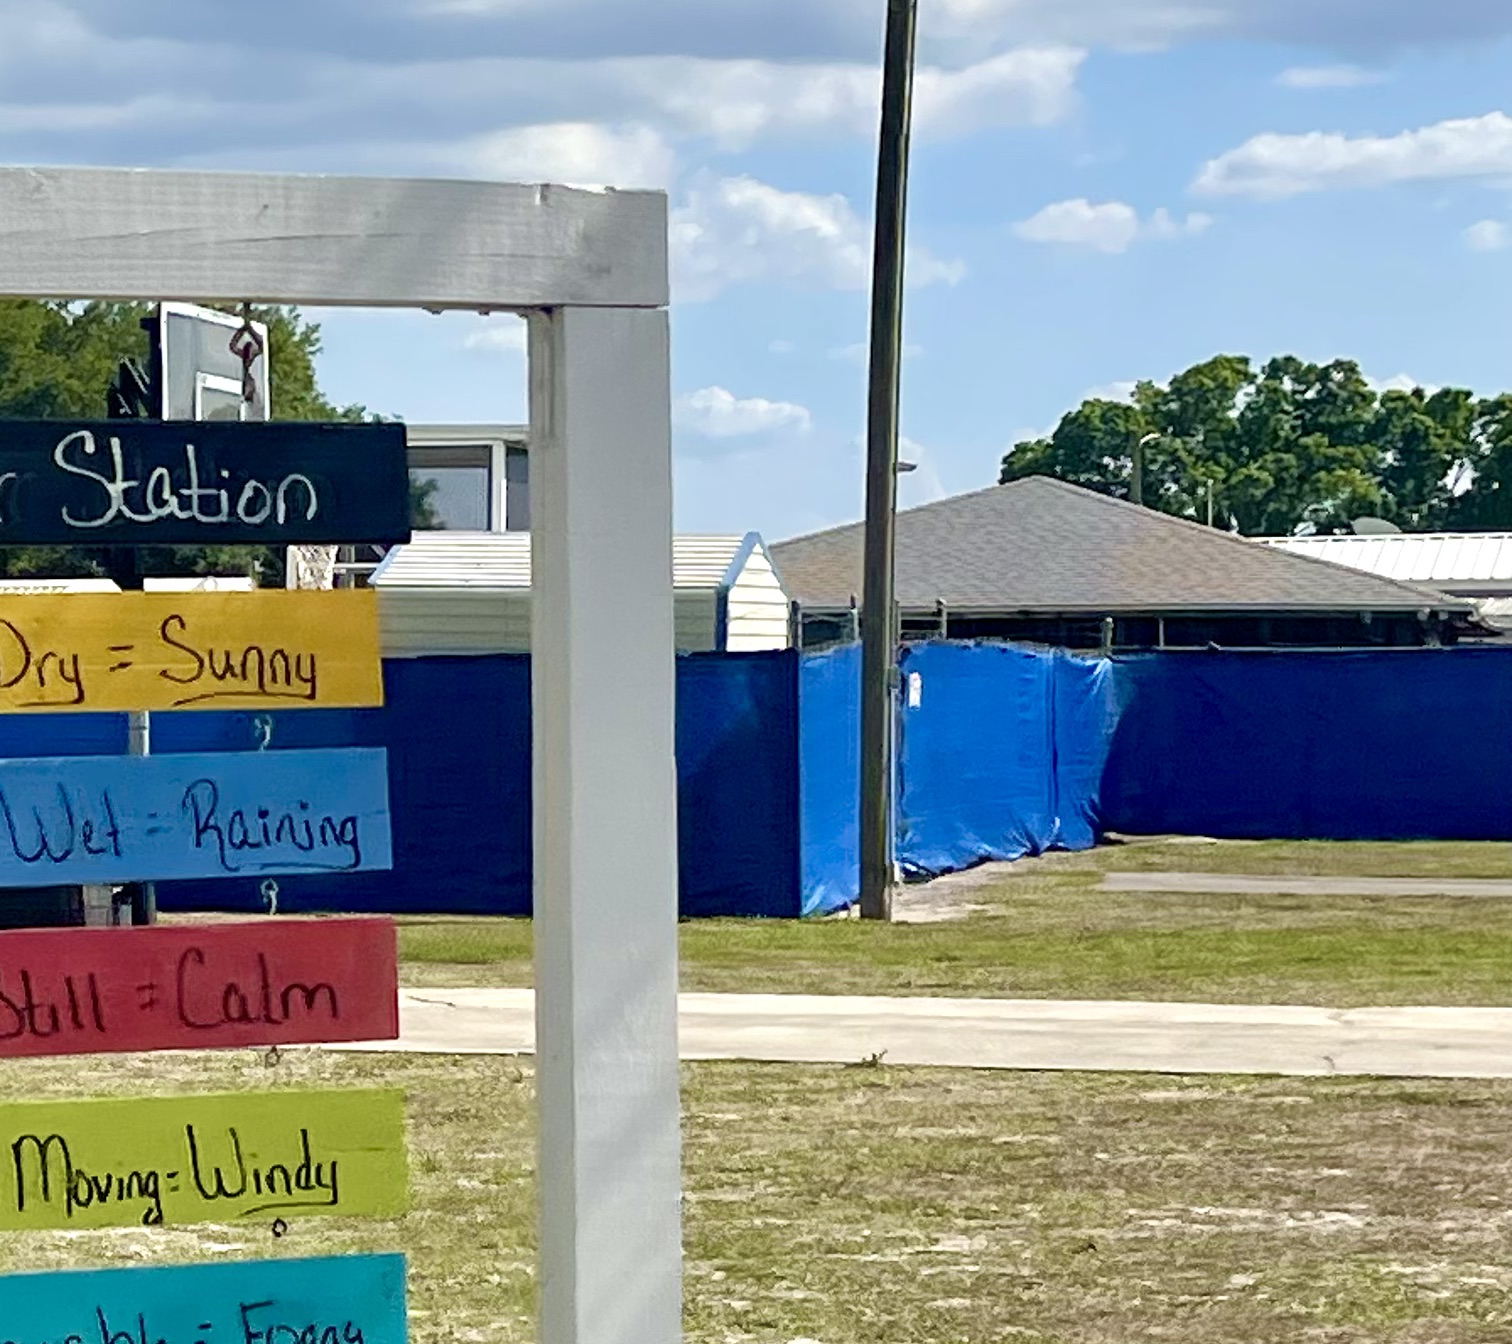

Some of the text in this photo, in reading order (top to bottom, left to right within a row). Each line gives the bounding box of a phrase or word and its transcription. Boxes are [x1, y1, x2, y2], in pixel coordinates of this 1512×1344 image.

[54, 431, 318, 528] Station
[158, 614, 317, 706] Sunny
[183, 778, 362, 870] Raining
[176, 946, 338, 1029] Calm
[11, 1133, 163, 1225] Moving
[186, 1123, 339, 1218] Windy
